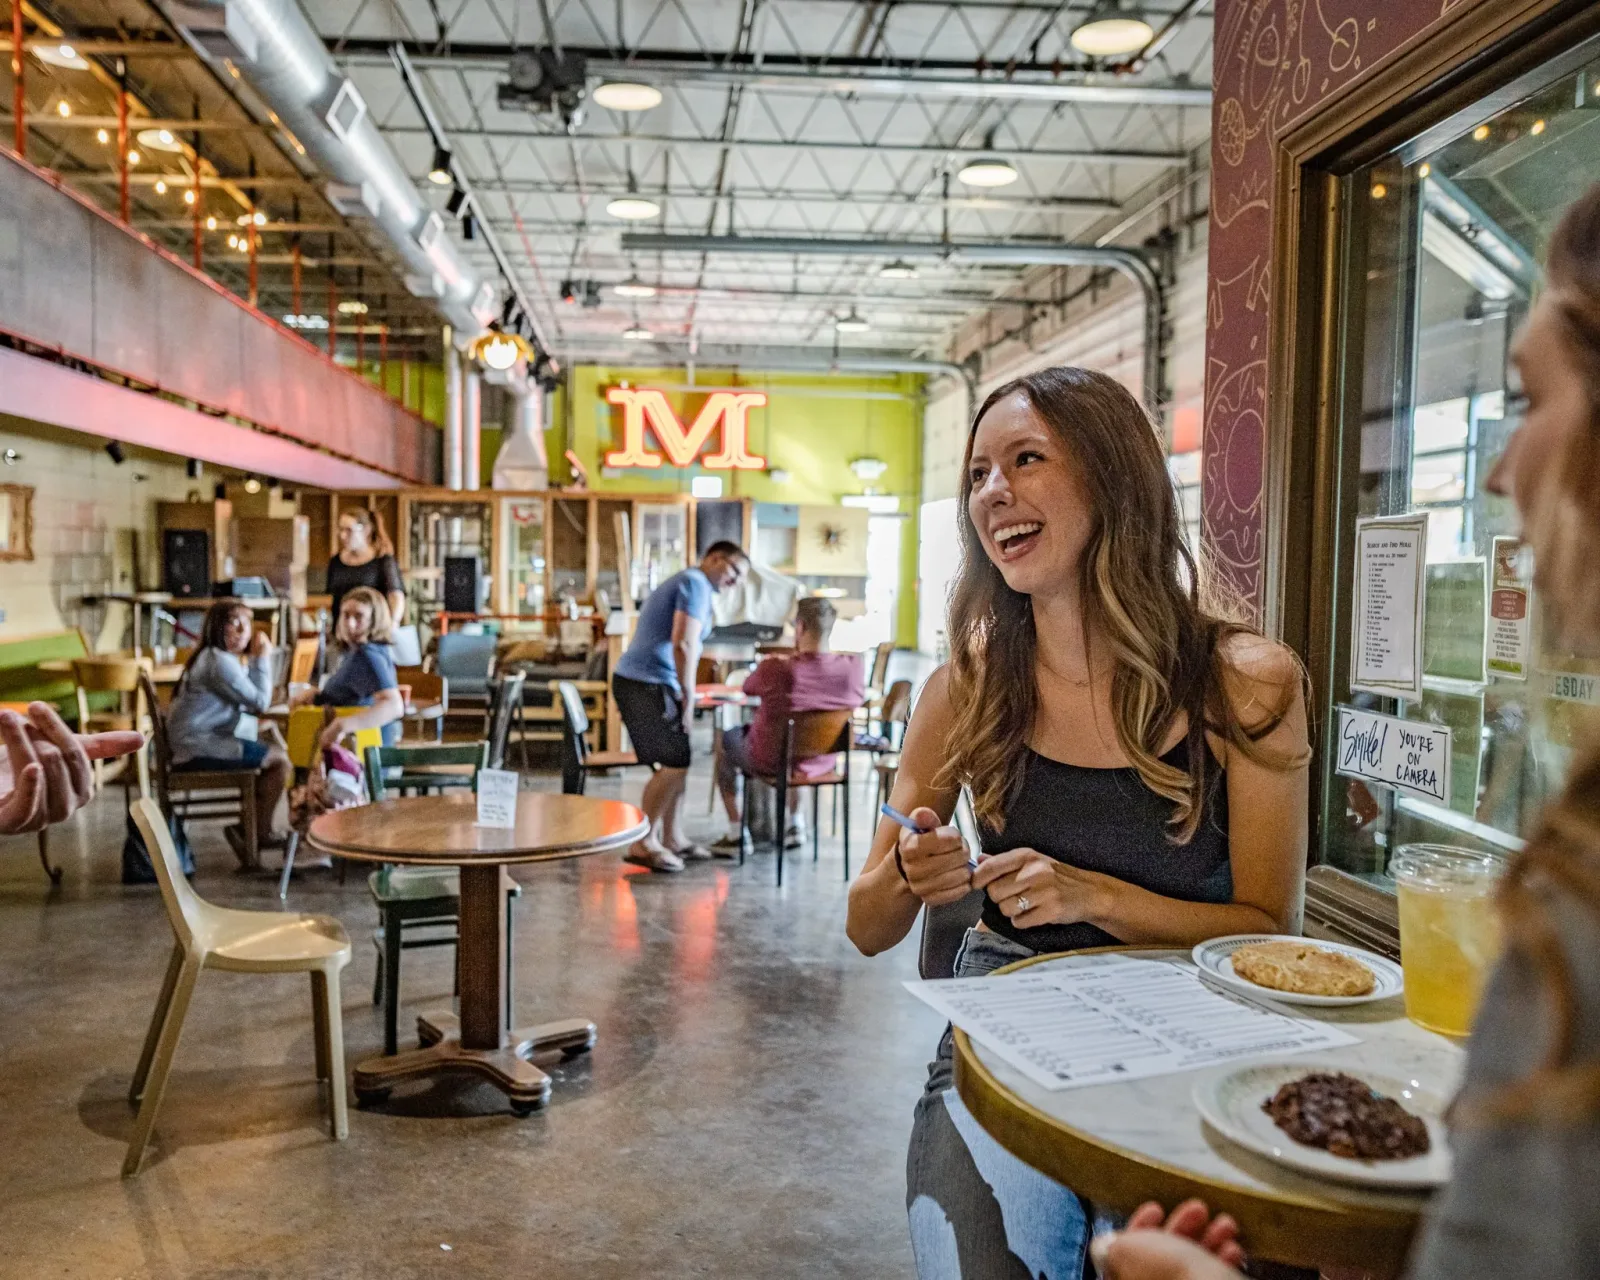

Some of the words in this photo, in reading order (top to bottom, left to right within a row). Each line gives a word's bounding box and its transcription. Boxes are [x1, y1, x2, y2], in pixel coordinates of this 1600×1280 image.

[606, 386, 769, 469] M
[1343, 718, 1388, 772] Smile!
[1399, 728, 1434, 754] YOU'RE
[1407, 752, 1421, 766] ON
[1396, 763, 1437, 794] CAMERA
